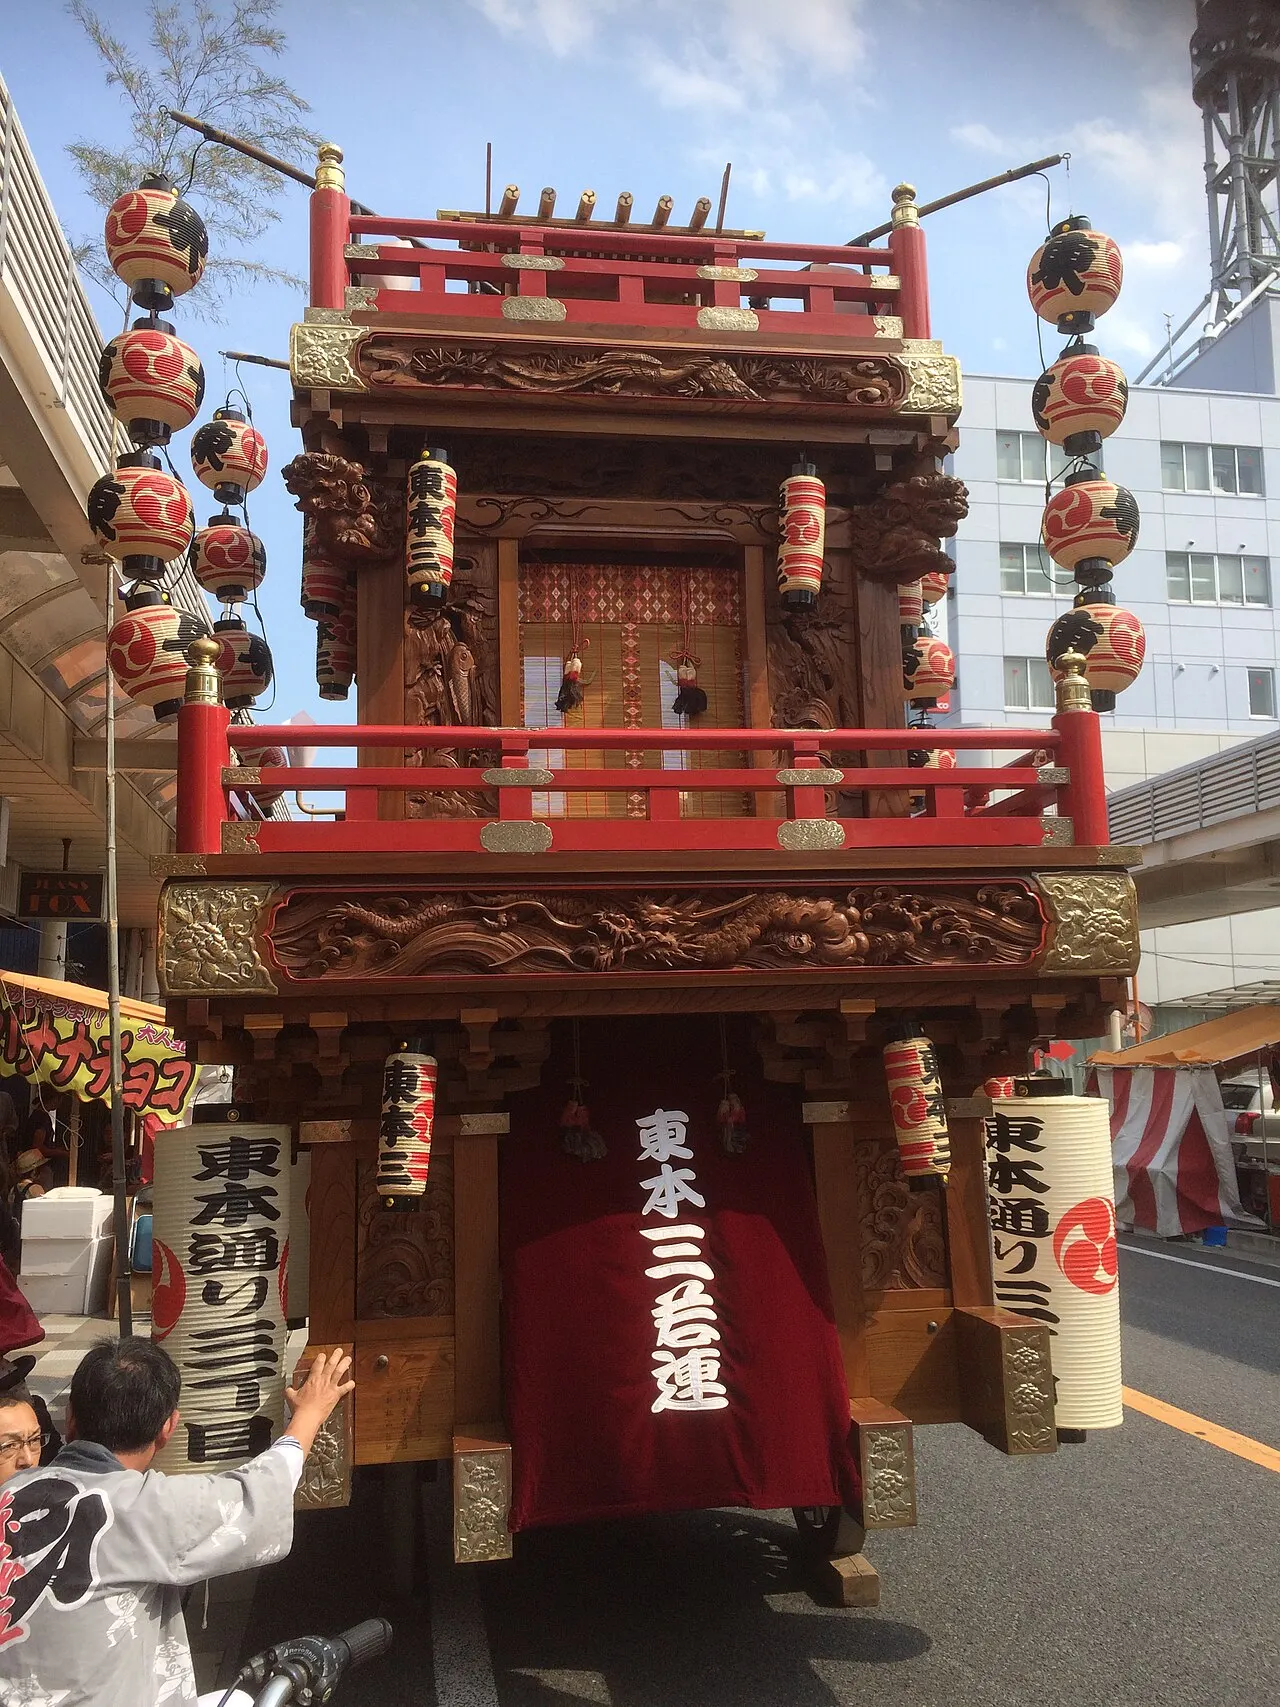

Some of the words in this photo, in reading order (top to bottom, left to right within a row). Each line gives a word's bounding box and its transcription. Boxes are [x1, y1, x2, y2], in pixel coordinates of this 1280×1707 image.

[1032, 232, 1099, 296] 東
[408, 465, 446, 575] 東本三
[28, 894, 92, 913] FOX
[377, 1059, 421, 1186] 東本三
[985, 1112, 1060, 1335] 東本通り三
[183, 1135, 282, 1464] 東本通り三丁目
